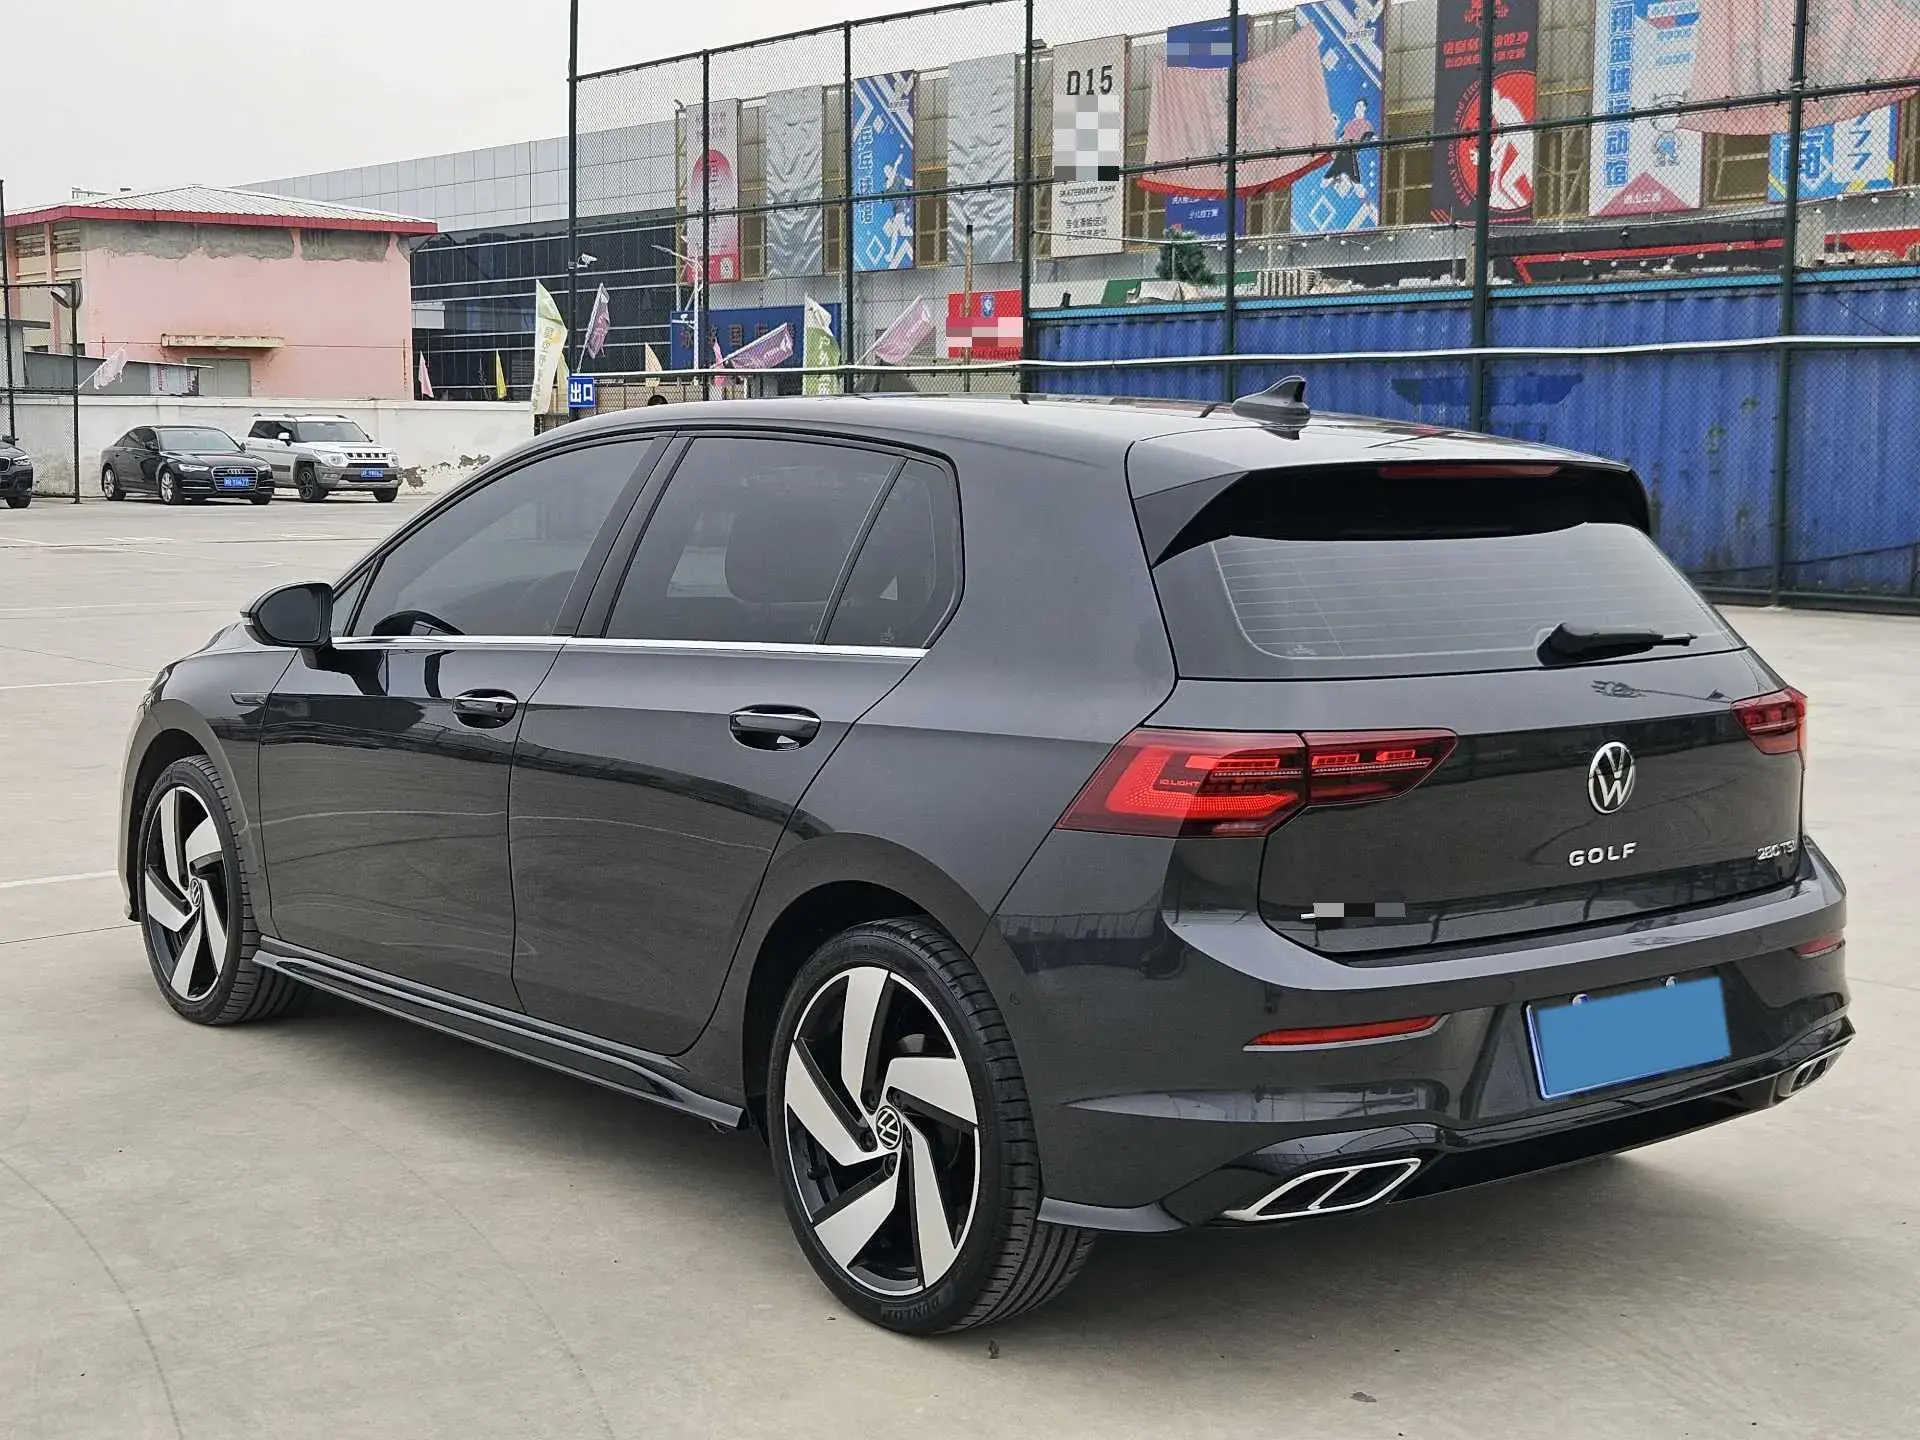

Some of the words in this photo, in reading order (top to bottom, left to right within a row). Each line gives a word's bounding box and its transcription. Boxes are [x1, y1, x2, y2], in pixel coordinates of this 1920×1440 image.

[1066, 64, 1113, 95] D15
[1603, 0, 1634, 187] 翔篮球运动馆
[570, 382, 593, 402] 出口
[1568, 842, 1637, 867] GOLF
